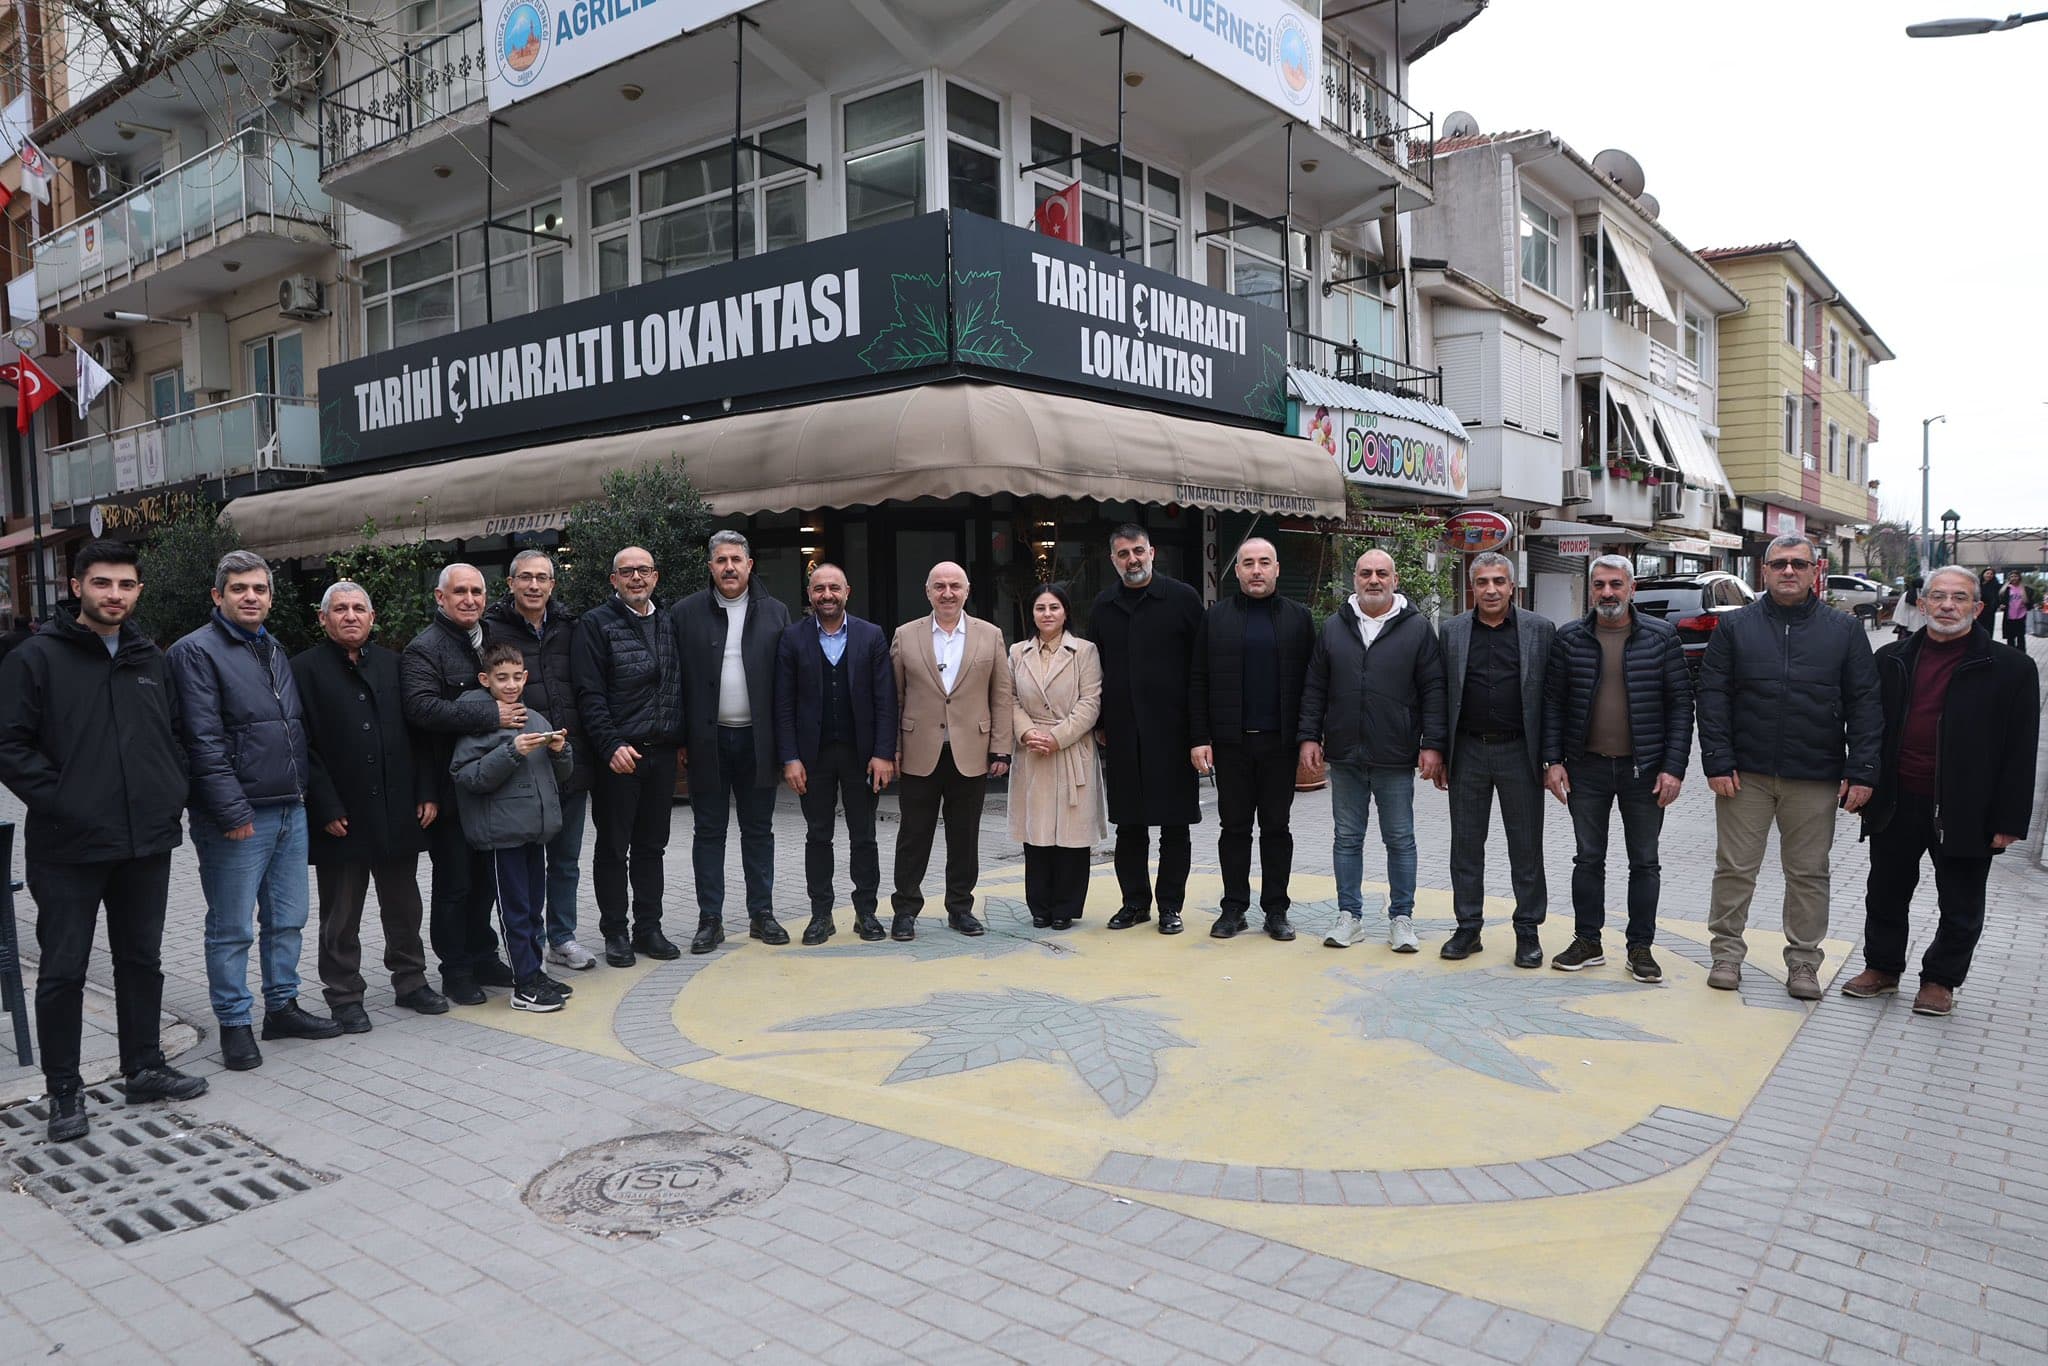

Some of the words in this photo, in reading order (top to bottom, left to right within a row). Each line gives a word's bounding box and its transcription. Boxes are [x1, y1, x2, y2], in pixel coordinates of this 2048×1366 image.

[1031, 252, 1126, 324] TARİHİ
[1132, 283, 1246, 355] ÇINARALTI
[354, 357, 441, 433] TARİHİ
[448, 319, 612, 424] ÇINARALTI
[622, 268, 861, 380] LOKANTASI
[1081, 327, 1213, 399] LOKANTASI
[1354, 413, 1378, 428] DUDO
[1347, 428, 1446, 487] DONDURMA
[1234, 490, 1265, 507] ESNAF
[1269, 495, 1316, 512] LOKANTASI
[1559, 538, 1589, 553] FOTOKOPİ
